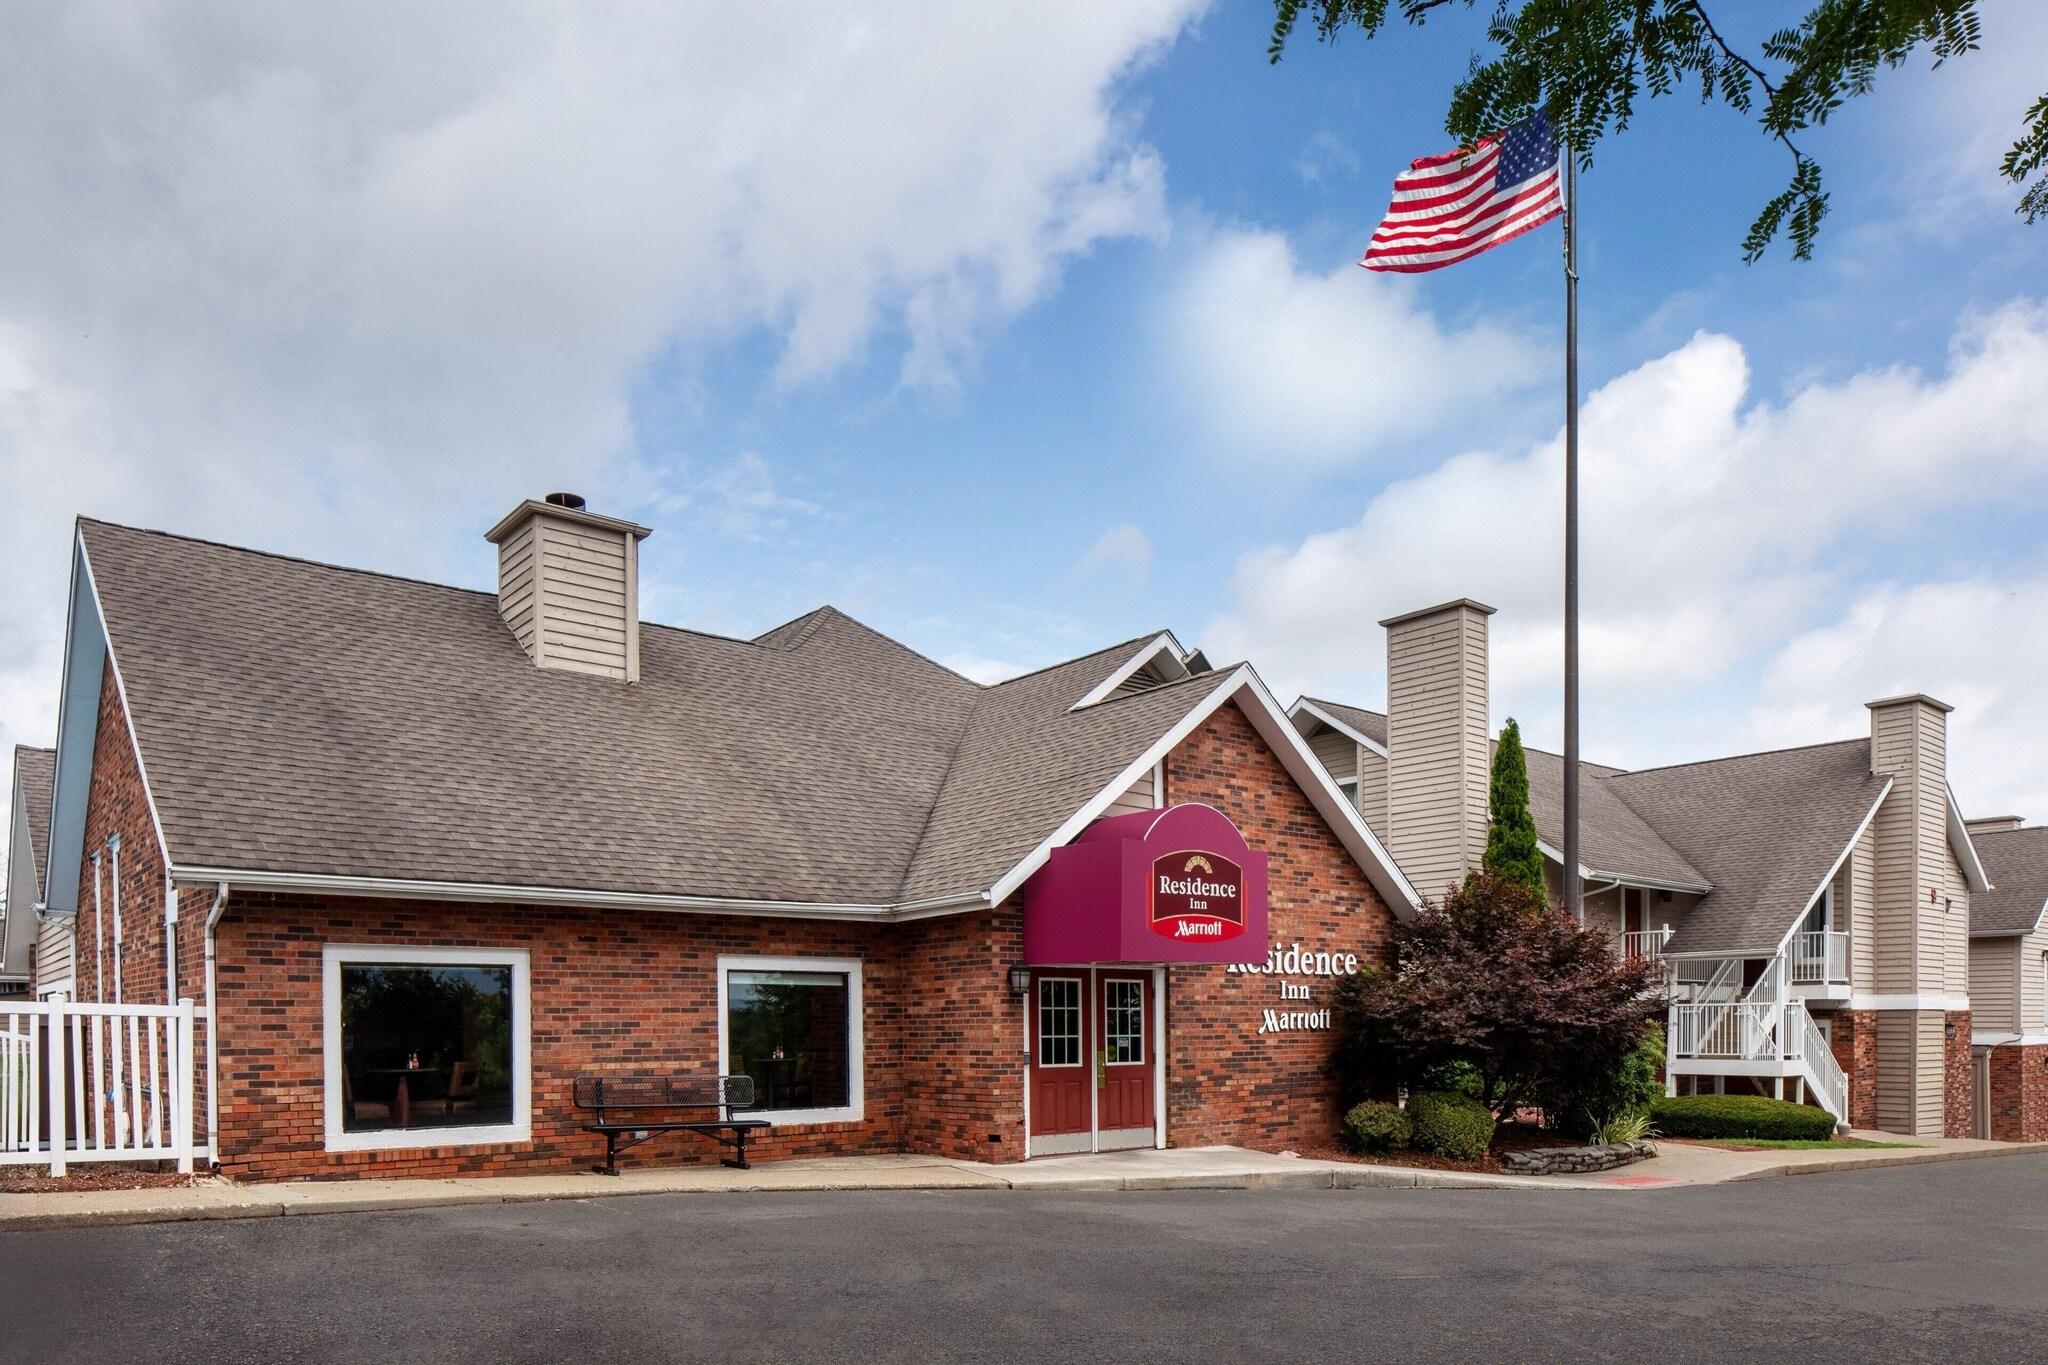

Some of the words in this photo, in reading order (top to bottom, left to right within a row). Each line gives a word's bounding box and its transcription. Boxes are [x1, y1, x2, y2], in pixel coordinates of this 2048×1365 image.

[1160, 876, 1236, 897] Residence
[1189, 898, 1207, 909] Inn
[1175, 920, 1222, 937] Marriott
[1227, 942, 1357, 975] sidence
[1280, 980, 1310, 999] Inn
[1258, 1008, 1331, 1034] Marriott
